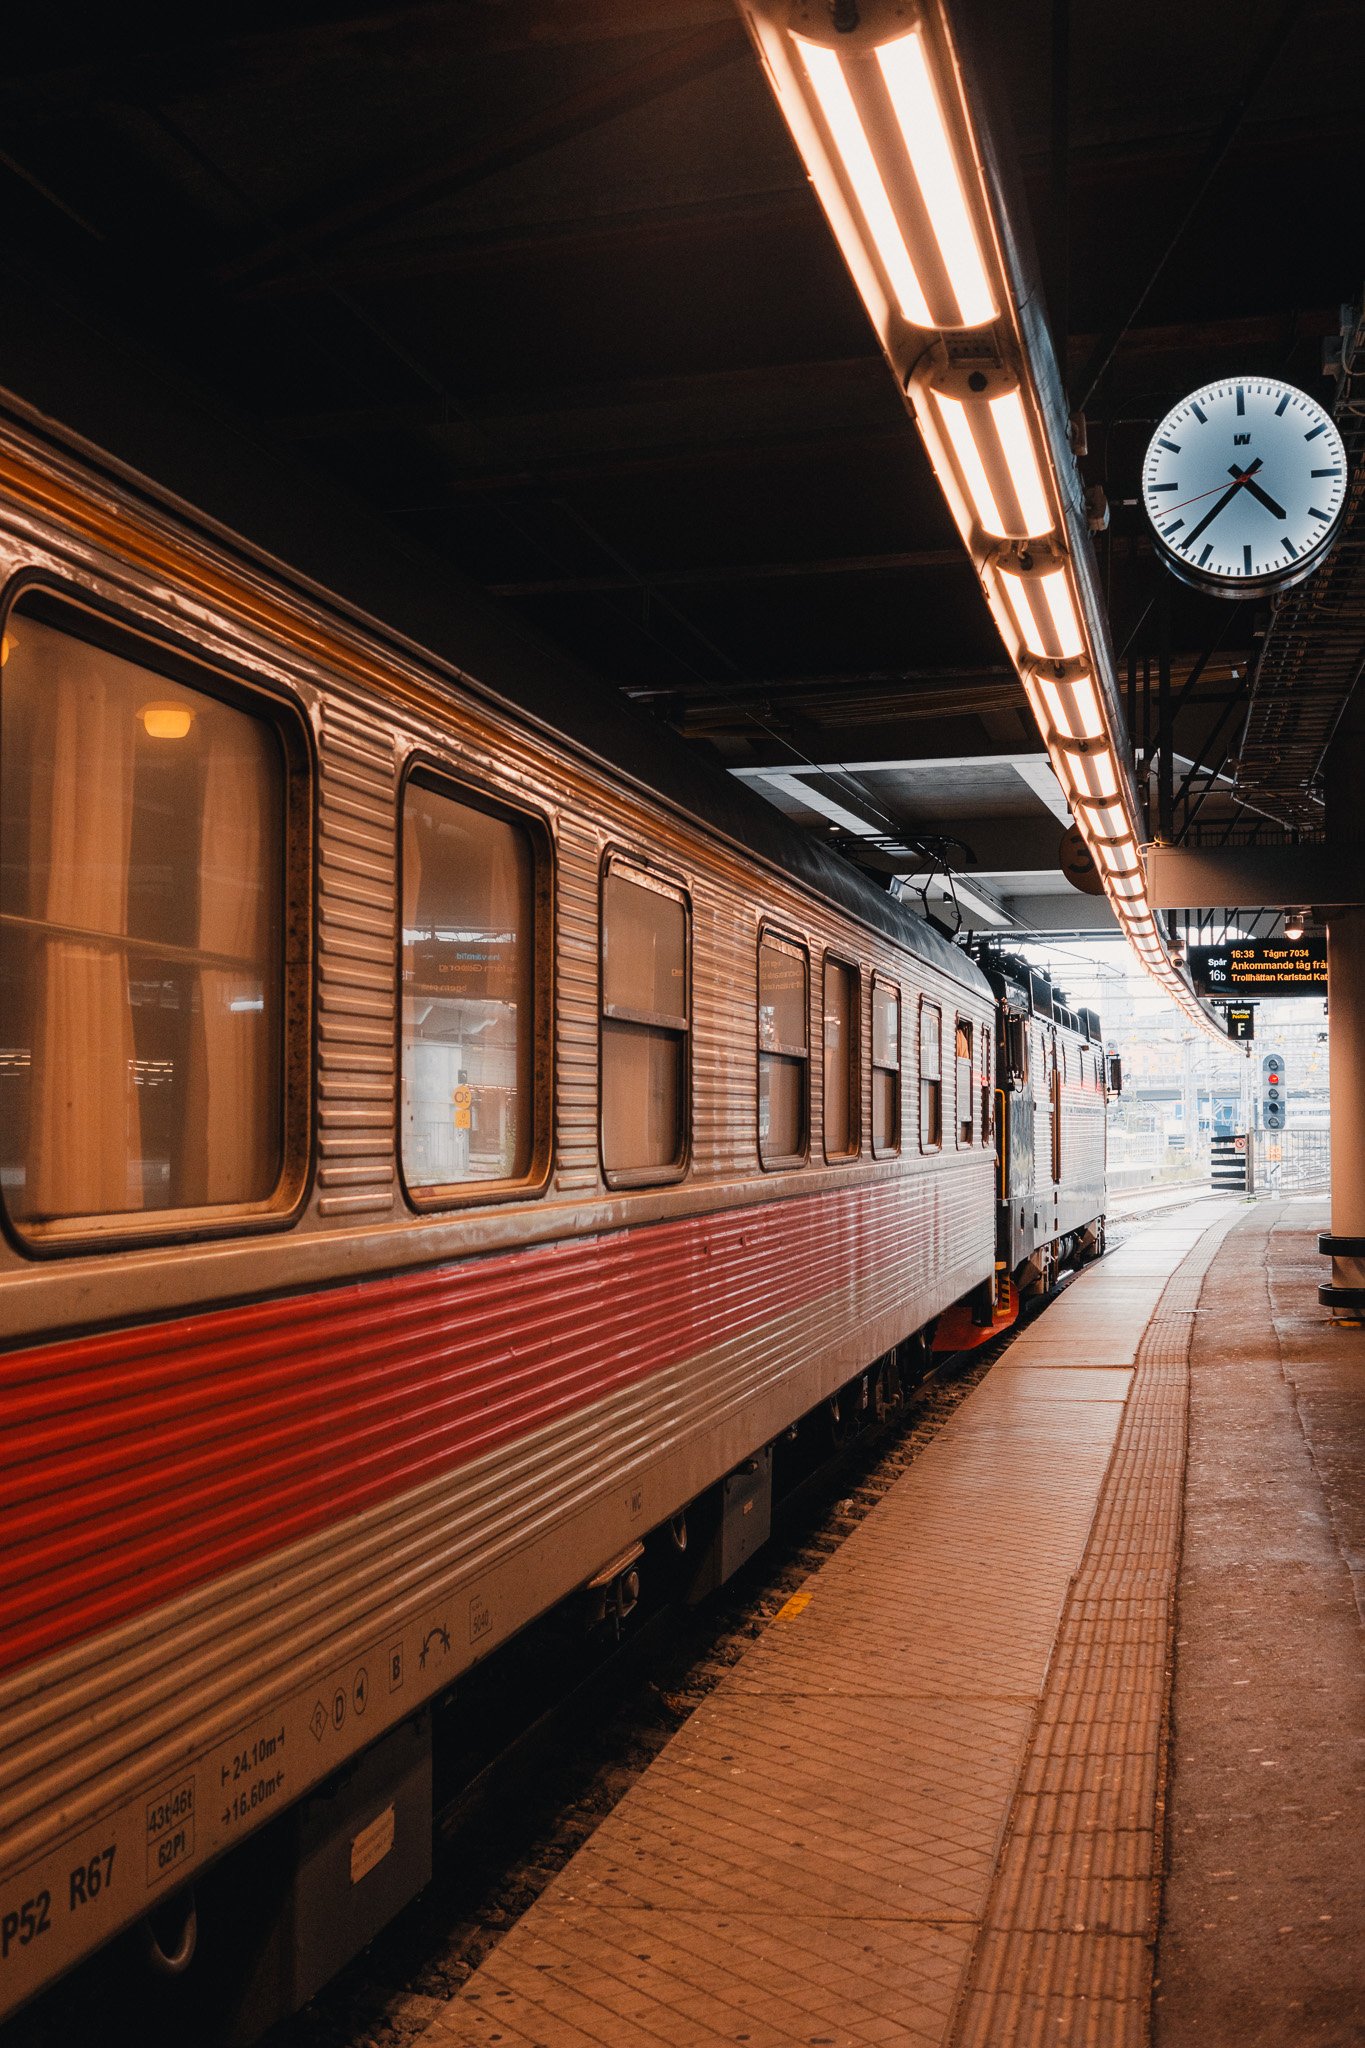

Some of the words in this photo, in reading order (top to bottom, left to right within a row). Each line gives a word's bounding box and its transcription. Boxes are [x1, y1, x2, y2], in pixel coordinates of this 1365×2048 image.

[1234, 433, 1251, 446] W
[1231, 950, 1255, 959] 16:38
[1263, 949, 1288, 959] Tågnr
[1289, 949, 1309, 957] 7034
[1208, 958, 1227, 967] Spår
[1231, 961, 1294, 970] Ankommande
[1296, 960, 1311, 971] tåg
[1209, 969, 1227, 981] 16b
[1231, 973, 1276, 982] Trollhättan
[1277, 973, 1313, 981] Karlstad
[1237, 1022, 1246, 1036] F
[392, 1654, 401, 1680] B
[232, 1736, 277, 1781] 24.10m
[232, 1780, 277, 1821] 16.60m
[1, 1889, 52, 1959] P52
[69, 1843, 117, 1912] R67
